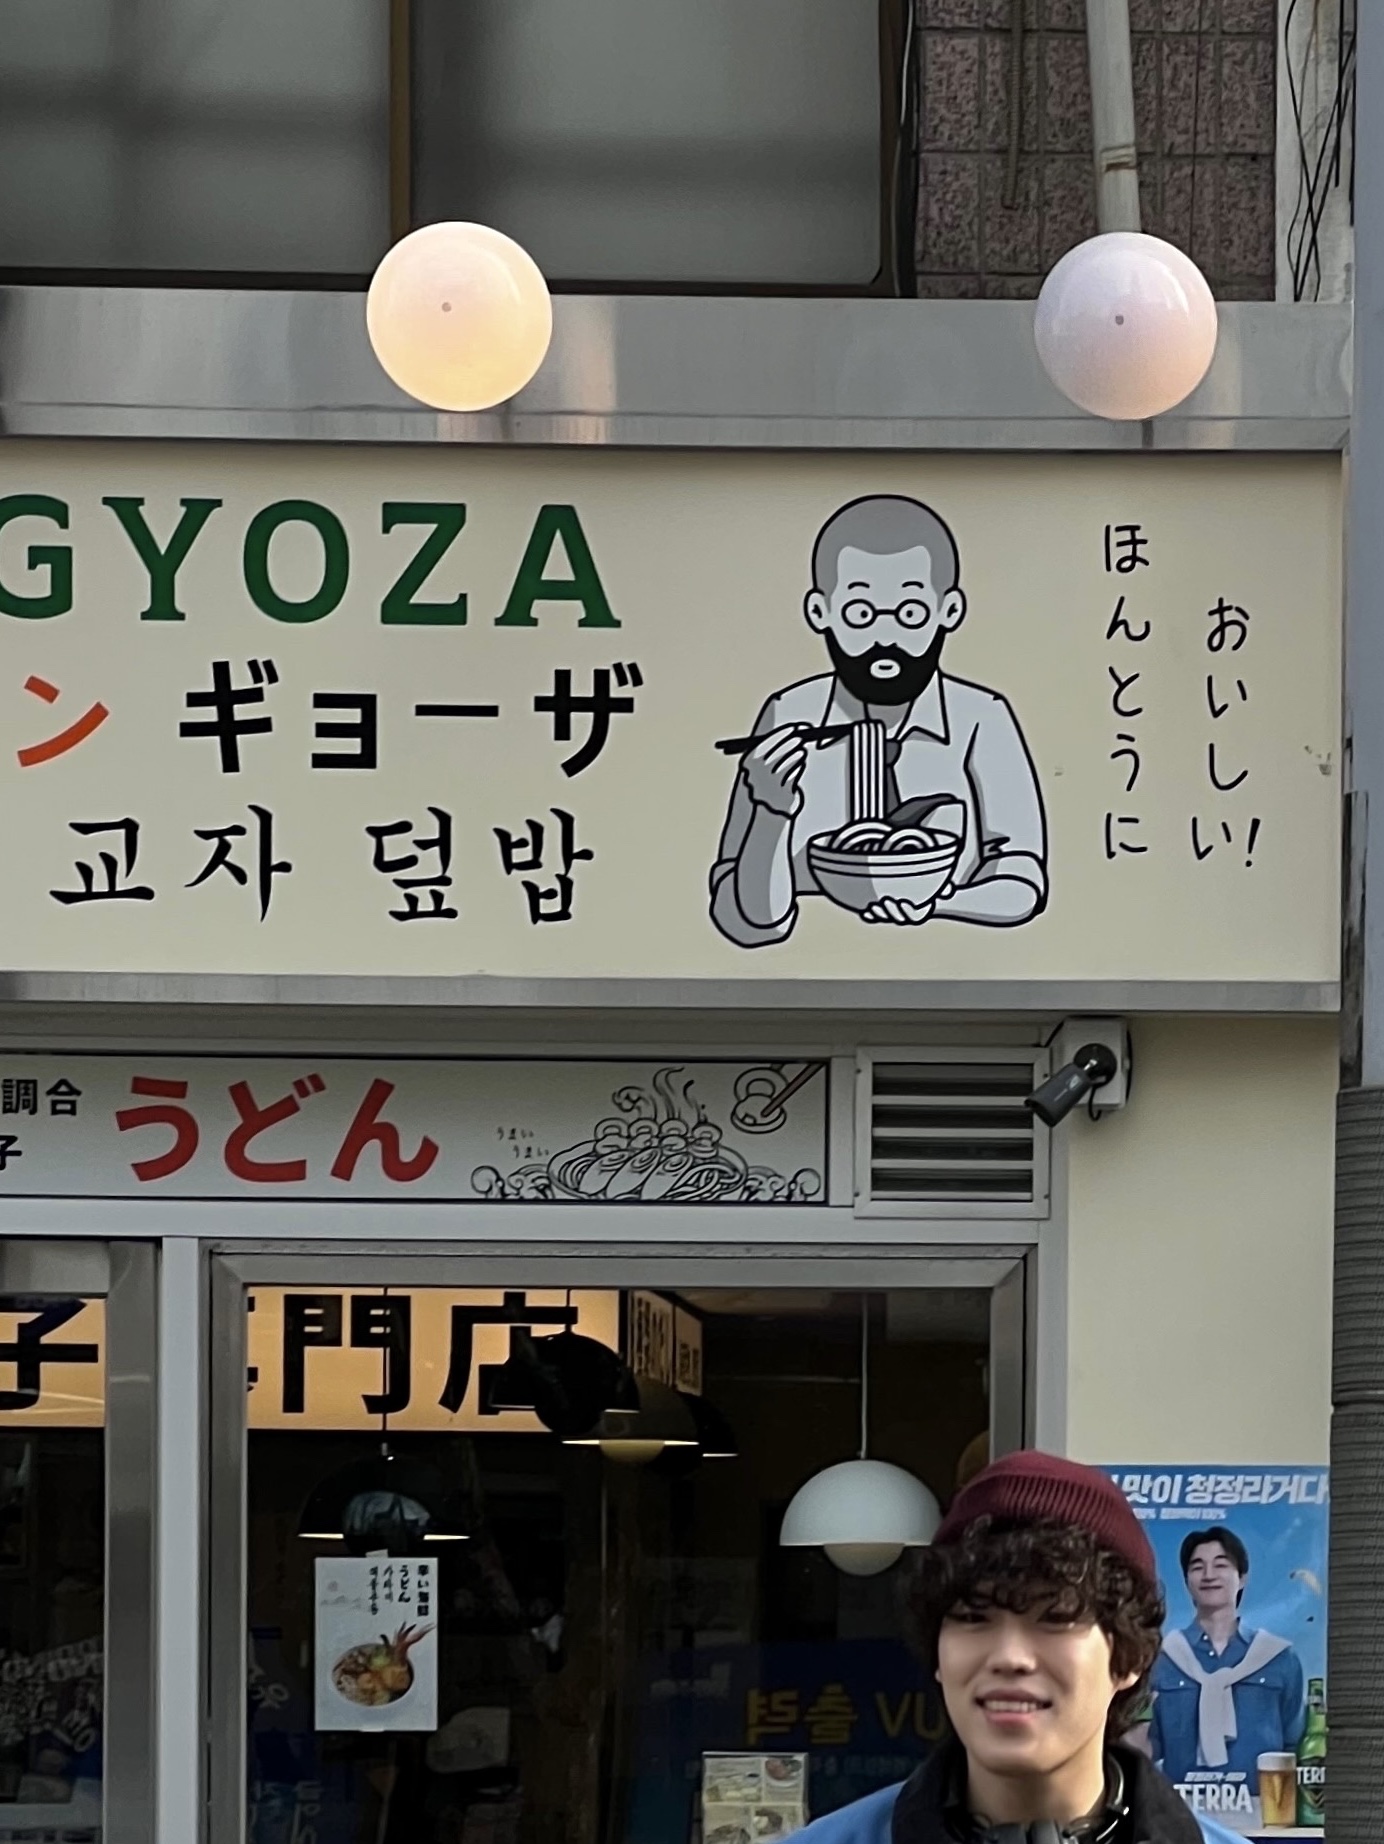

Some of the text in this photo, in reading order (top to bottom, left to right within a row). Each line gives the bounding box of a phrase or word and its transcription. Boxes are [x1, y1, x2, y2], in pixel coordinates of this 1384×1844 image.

[0, 493, 622, 628] GYOZA
[179, 659, 644, 778] ギョーザ
[1103, 523, 1151, 860] ほんとうに
[50, 804, 594, 926] 교자 덮밥
[115, 1073, 440, 1183] うどん
[248, 1292, 578, 1414] 門店
[1173, 1783, 1254, 1814] TERRA
